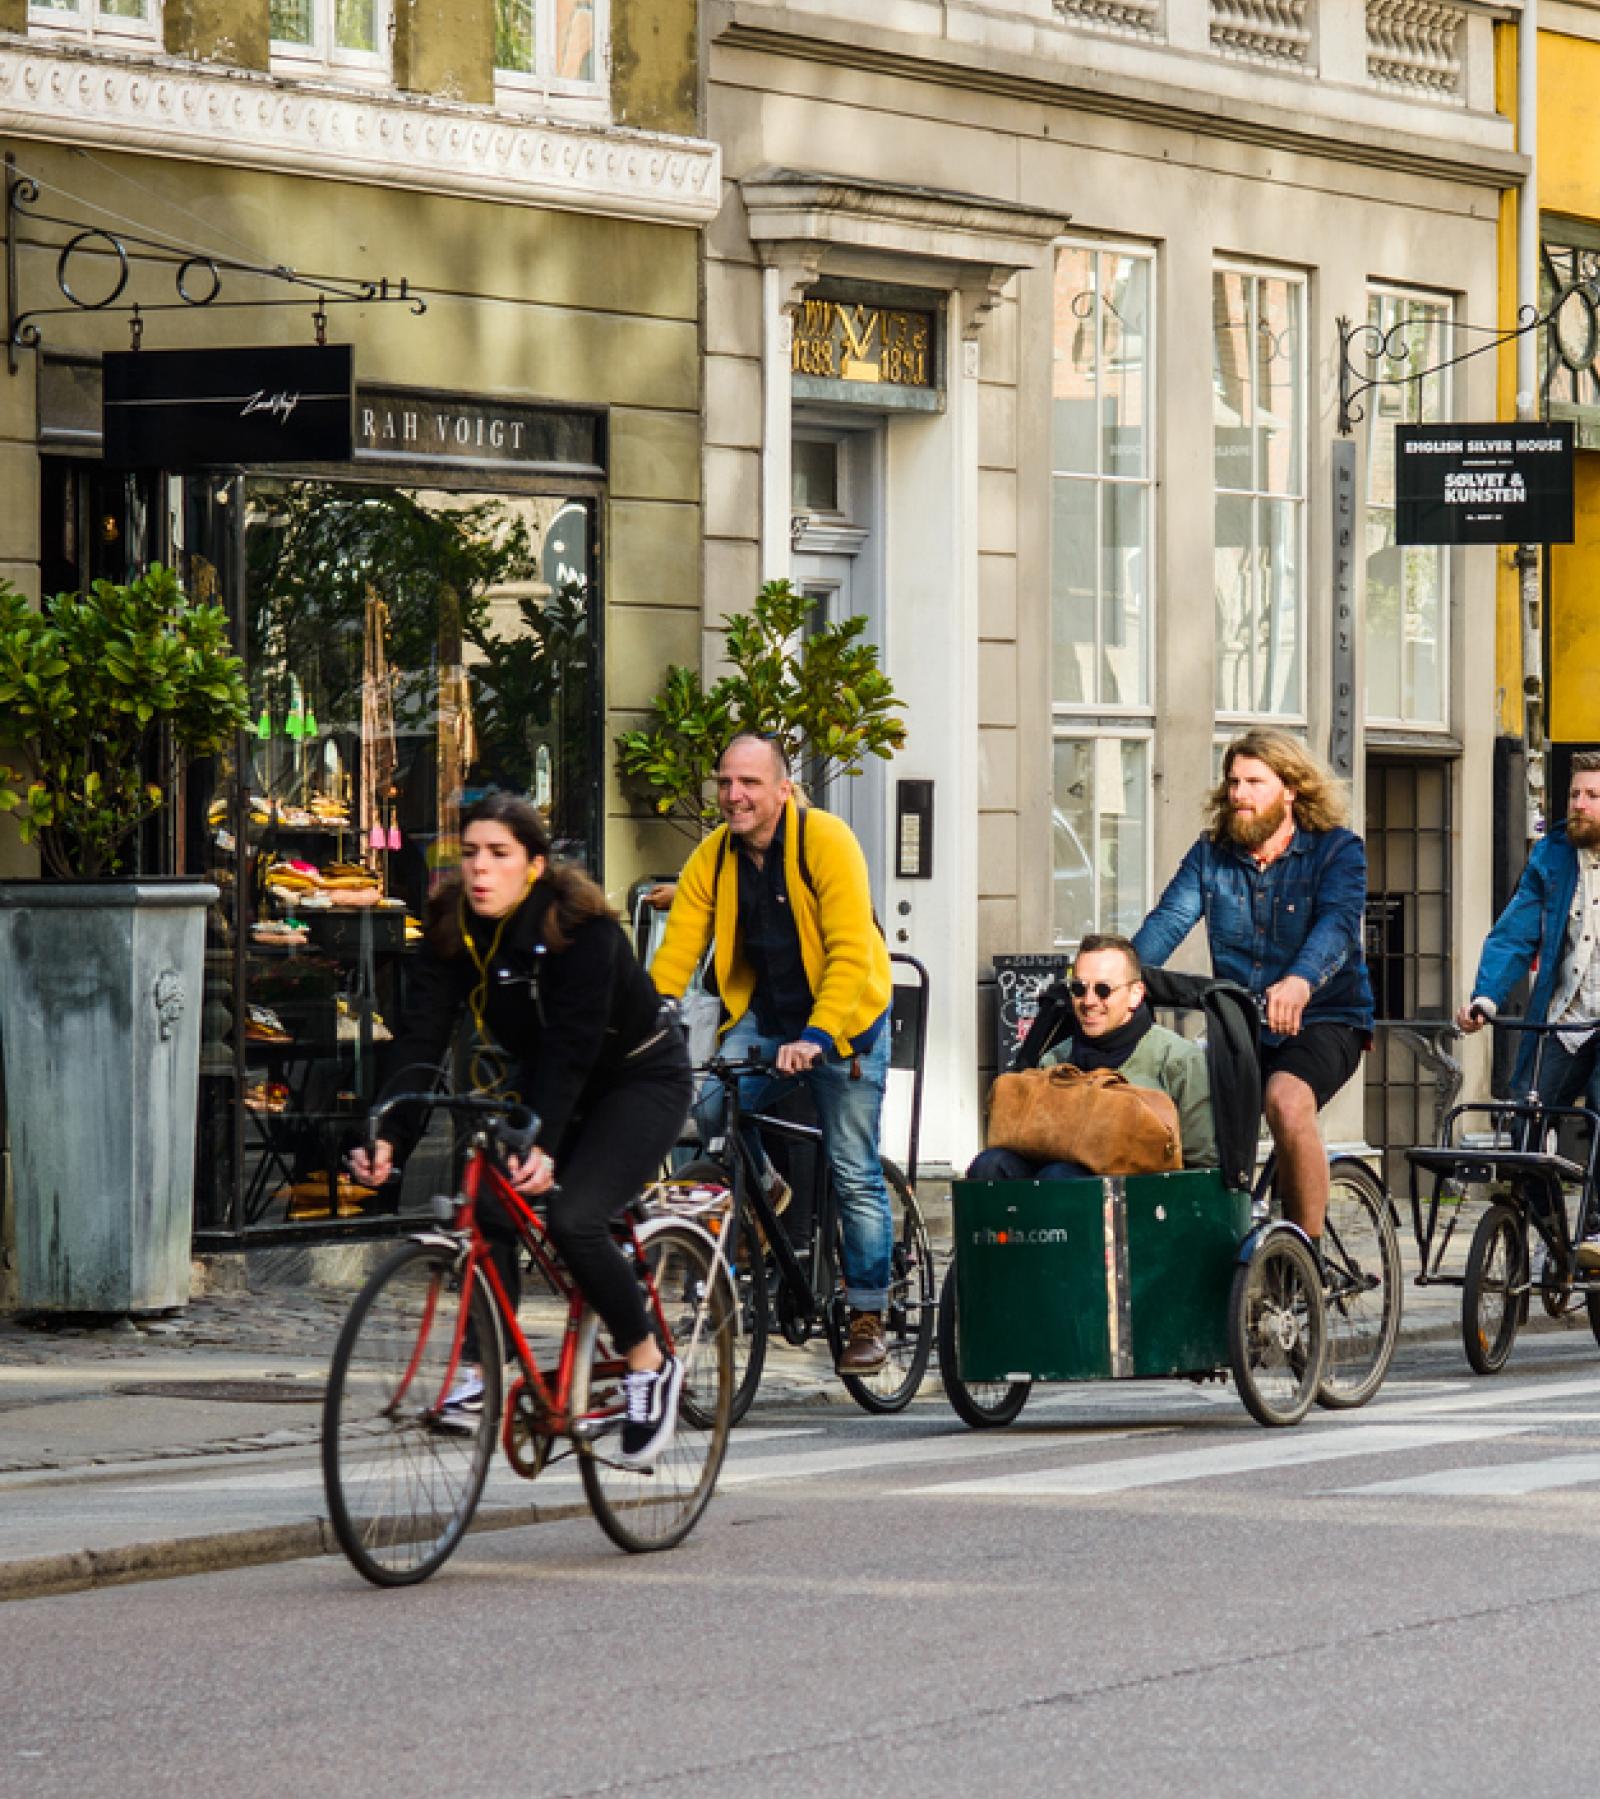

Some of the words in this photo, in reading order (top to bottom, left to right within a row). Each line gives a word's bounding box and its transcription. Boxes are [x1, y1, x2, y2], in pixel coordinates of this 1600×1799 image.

[362, 409, 417, 440] RAH
[435, 414, 525, 449] VOIGT
[1404, 440, 1463, 453] ENGLISH
[1467, 440, 1512, 453] SILVER
[1515, 439, 1563, 452] HOUSE
[1509, 472, 1525, 488] &
[1444, 487, 1527, 504] KUNSTEN
